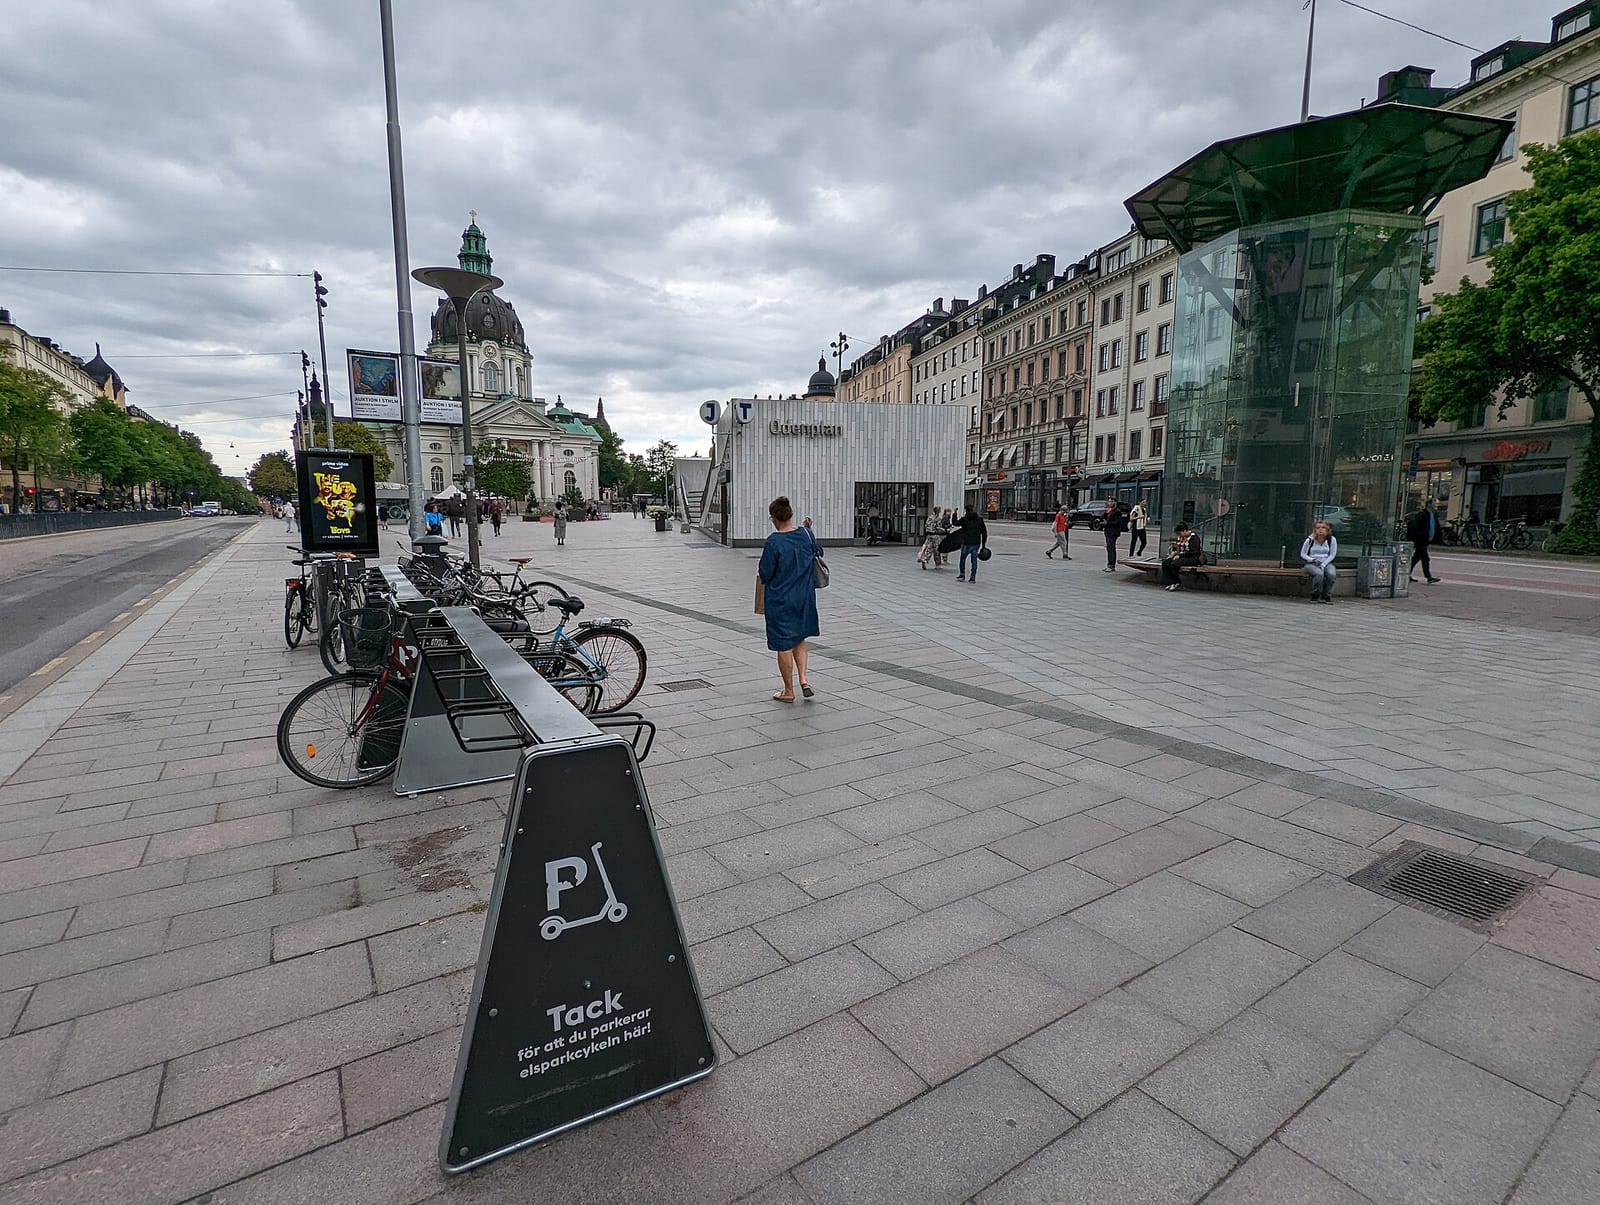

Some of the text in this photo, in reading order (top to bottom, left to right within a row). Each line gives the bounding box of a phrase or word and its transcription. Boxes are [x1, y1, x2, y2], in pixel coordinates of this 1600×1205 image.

[705, 403, 716, 421] J
[739, 403, 752, 420] T
[769, 420, 843, 440] Odenplan
[544, 855, 588, 911] P
[546, 989, 624, 1032] Tack
[517, 1008, 652, 1062] för att du parkerar
[519, 1022, 651, 1079] elsparkcykeln här!
